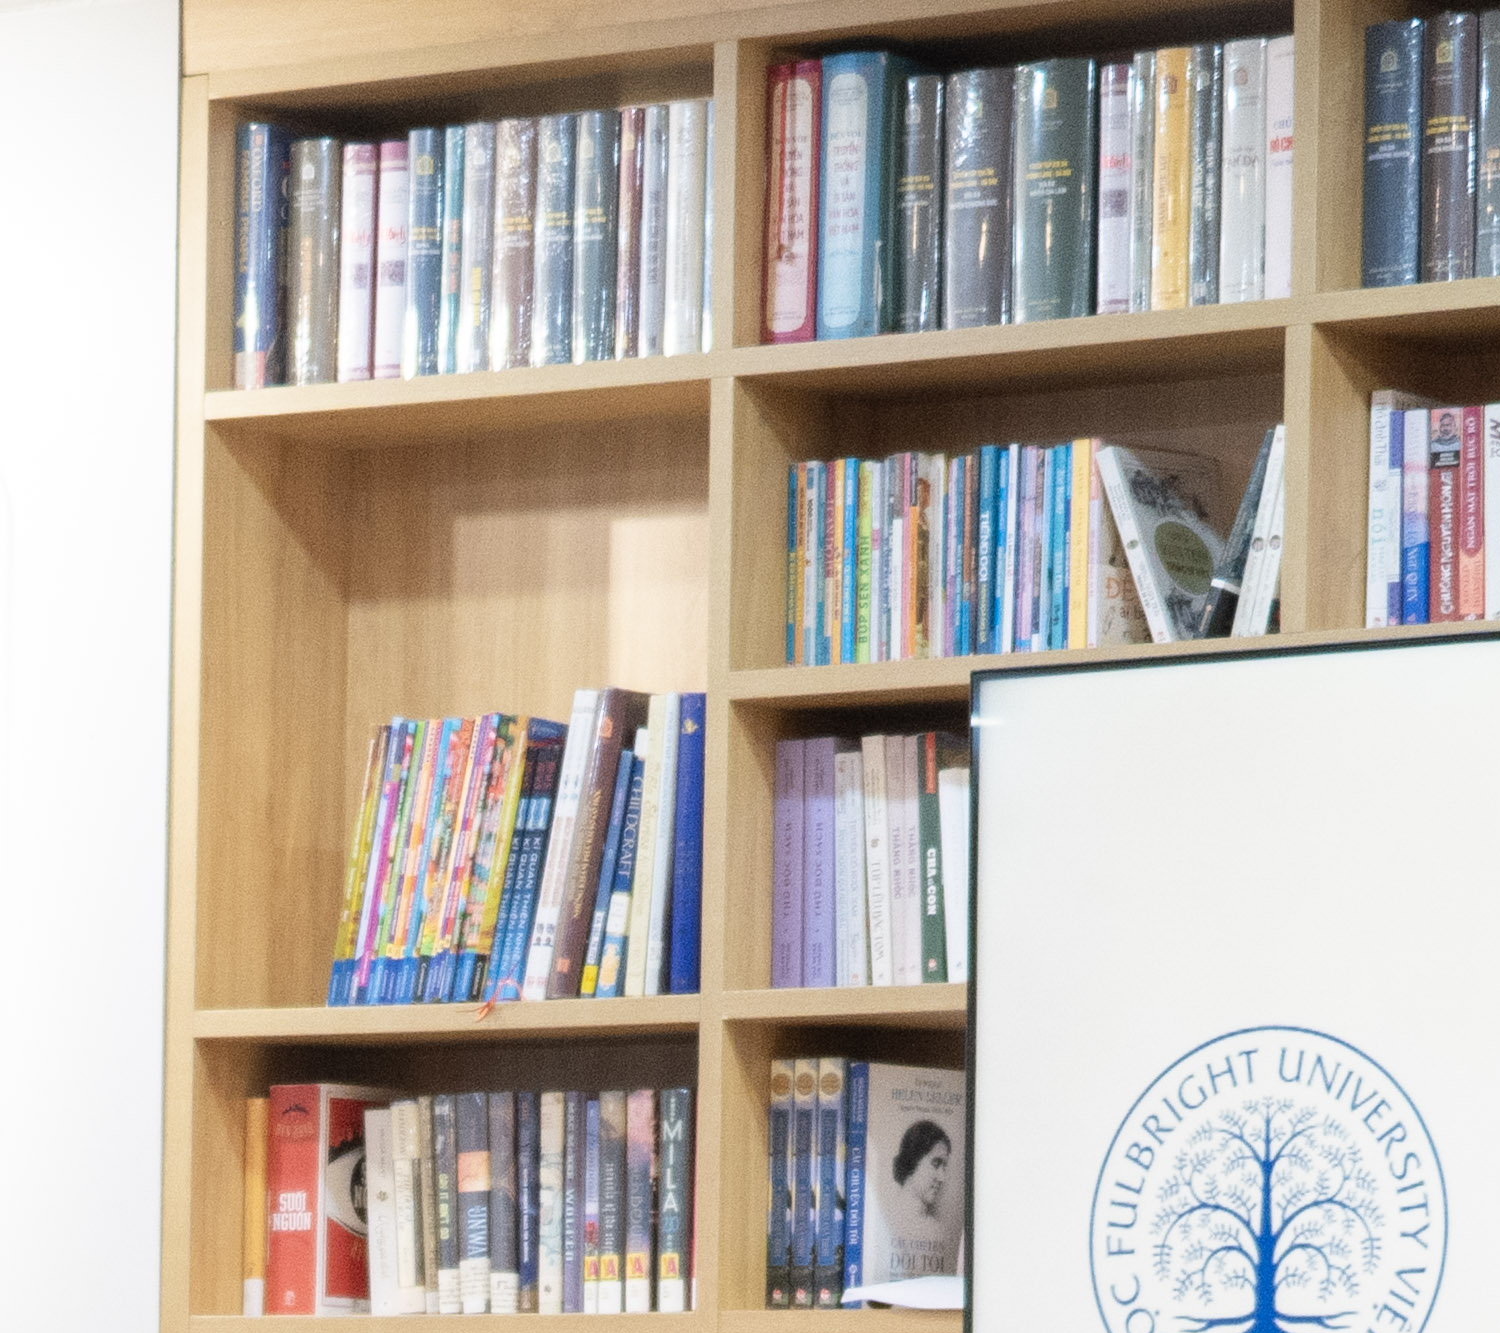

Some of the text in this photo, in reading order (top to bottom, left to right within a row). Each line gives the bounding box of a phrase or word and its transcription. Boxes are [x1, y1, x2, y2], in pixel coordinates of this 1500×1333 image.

[618, 776, 644, 880] CHILDCRAFT
[1106, 1047, 1260, 1257] FULBRIGHT
[1278, 1047, 1430, 1250] UNIVERSITY
